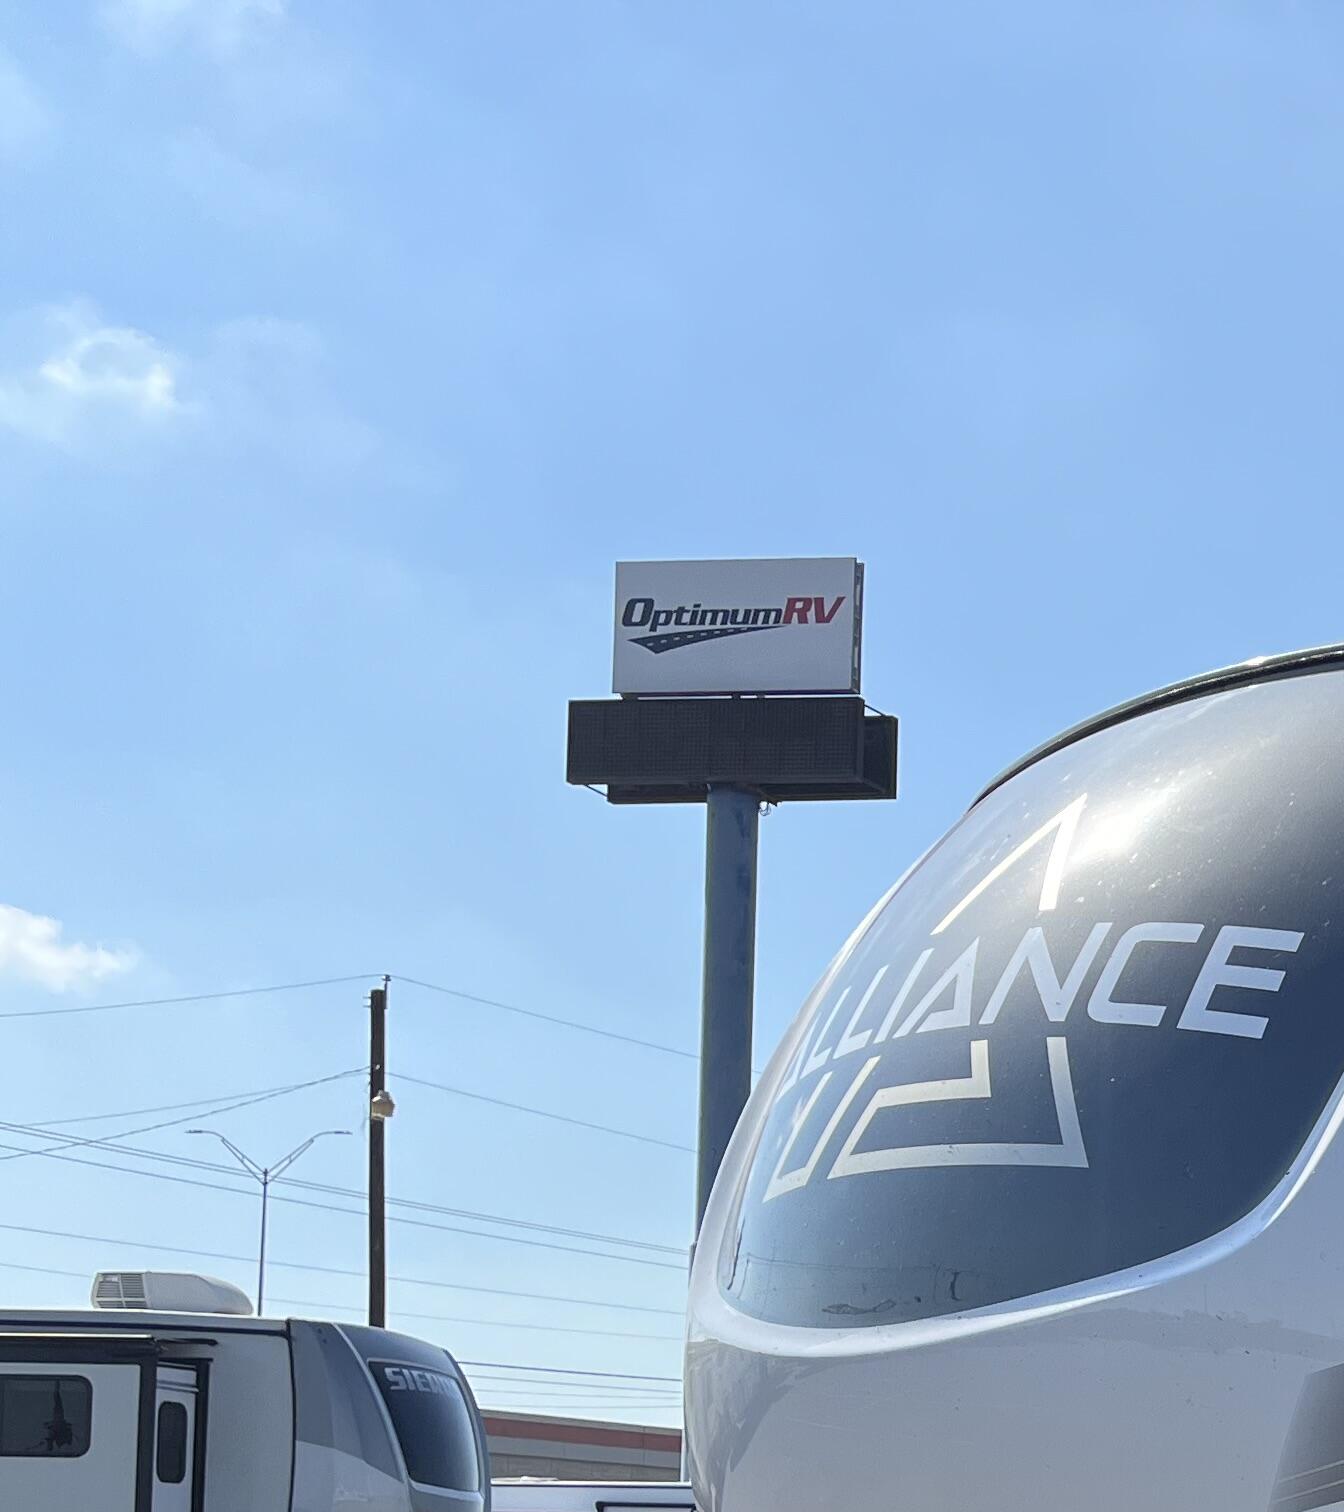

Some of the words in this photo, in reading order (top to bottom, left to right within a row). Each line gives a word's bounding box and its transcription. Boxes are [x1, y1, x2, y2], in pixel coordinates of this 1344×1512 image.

[621, 596, 847, 632] OptimumRV
[774, 921, 1305, 1104] ALLIANCE
[384, 1366, 455, 1396] SIE
